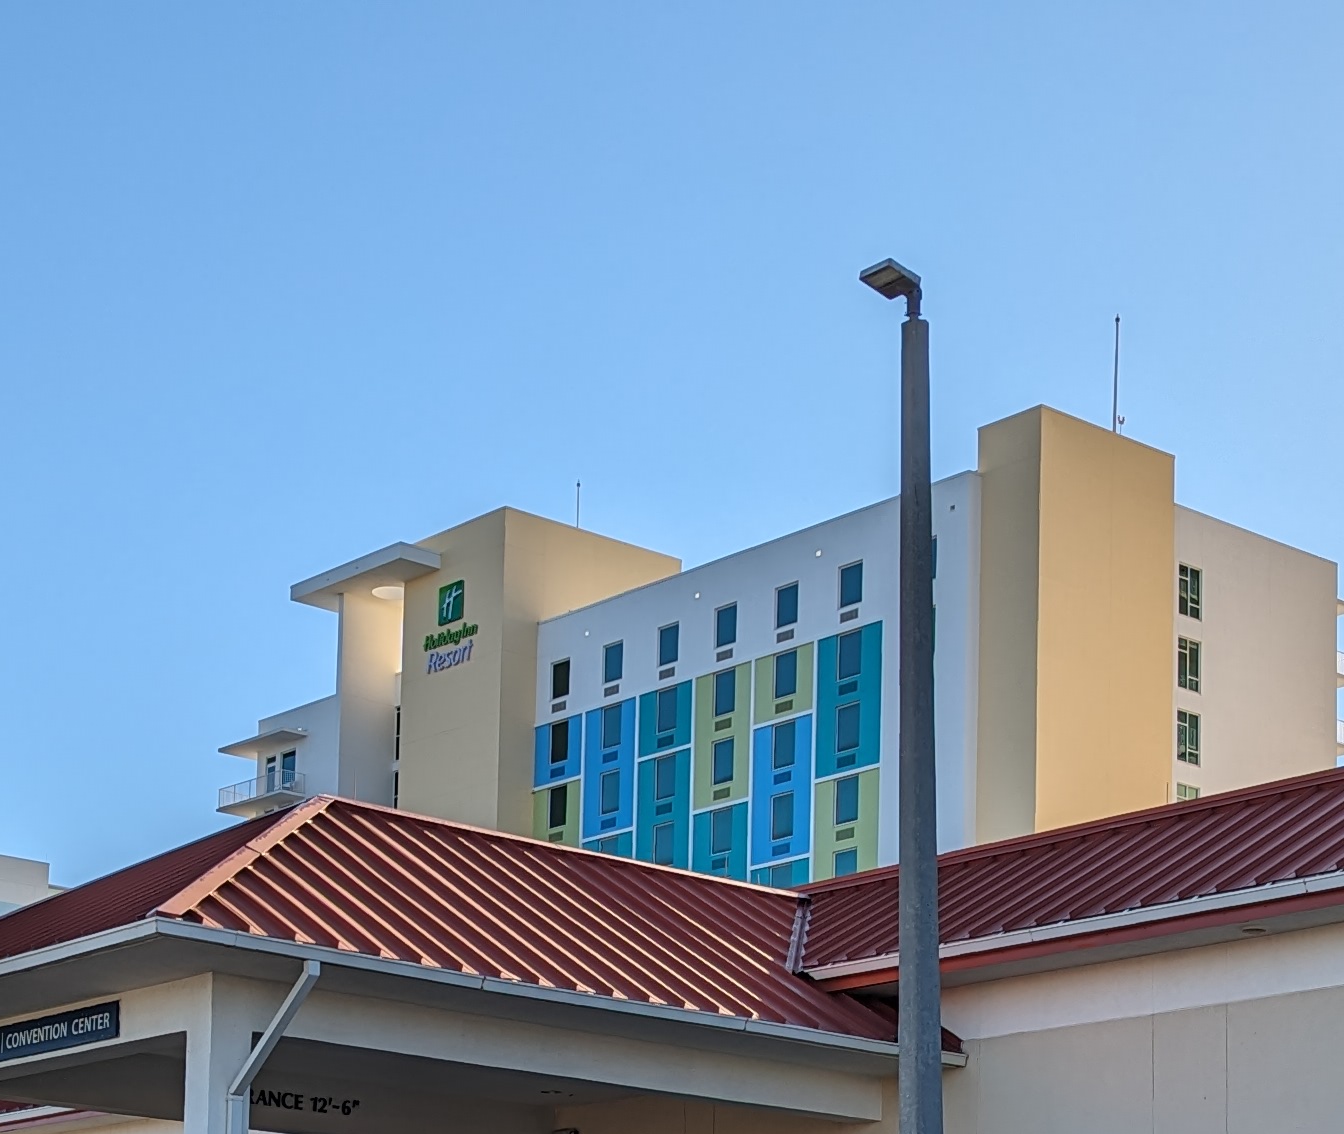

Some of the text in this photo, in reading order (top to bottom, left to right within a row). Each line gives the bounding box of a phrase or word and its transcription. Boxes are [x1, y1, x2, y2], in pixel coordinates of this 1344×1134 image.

[427, 639, 473, 674] Resort
[6, 1022, 68, 1049] CONVENTION
[71, 1012, 110, 1035] CENTER
